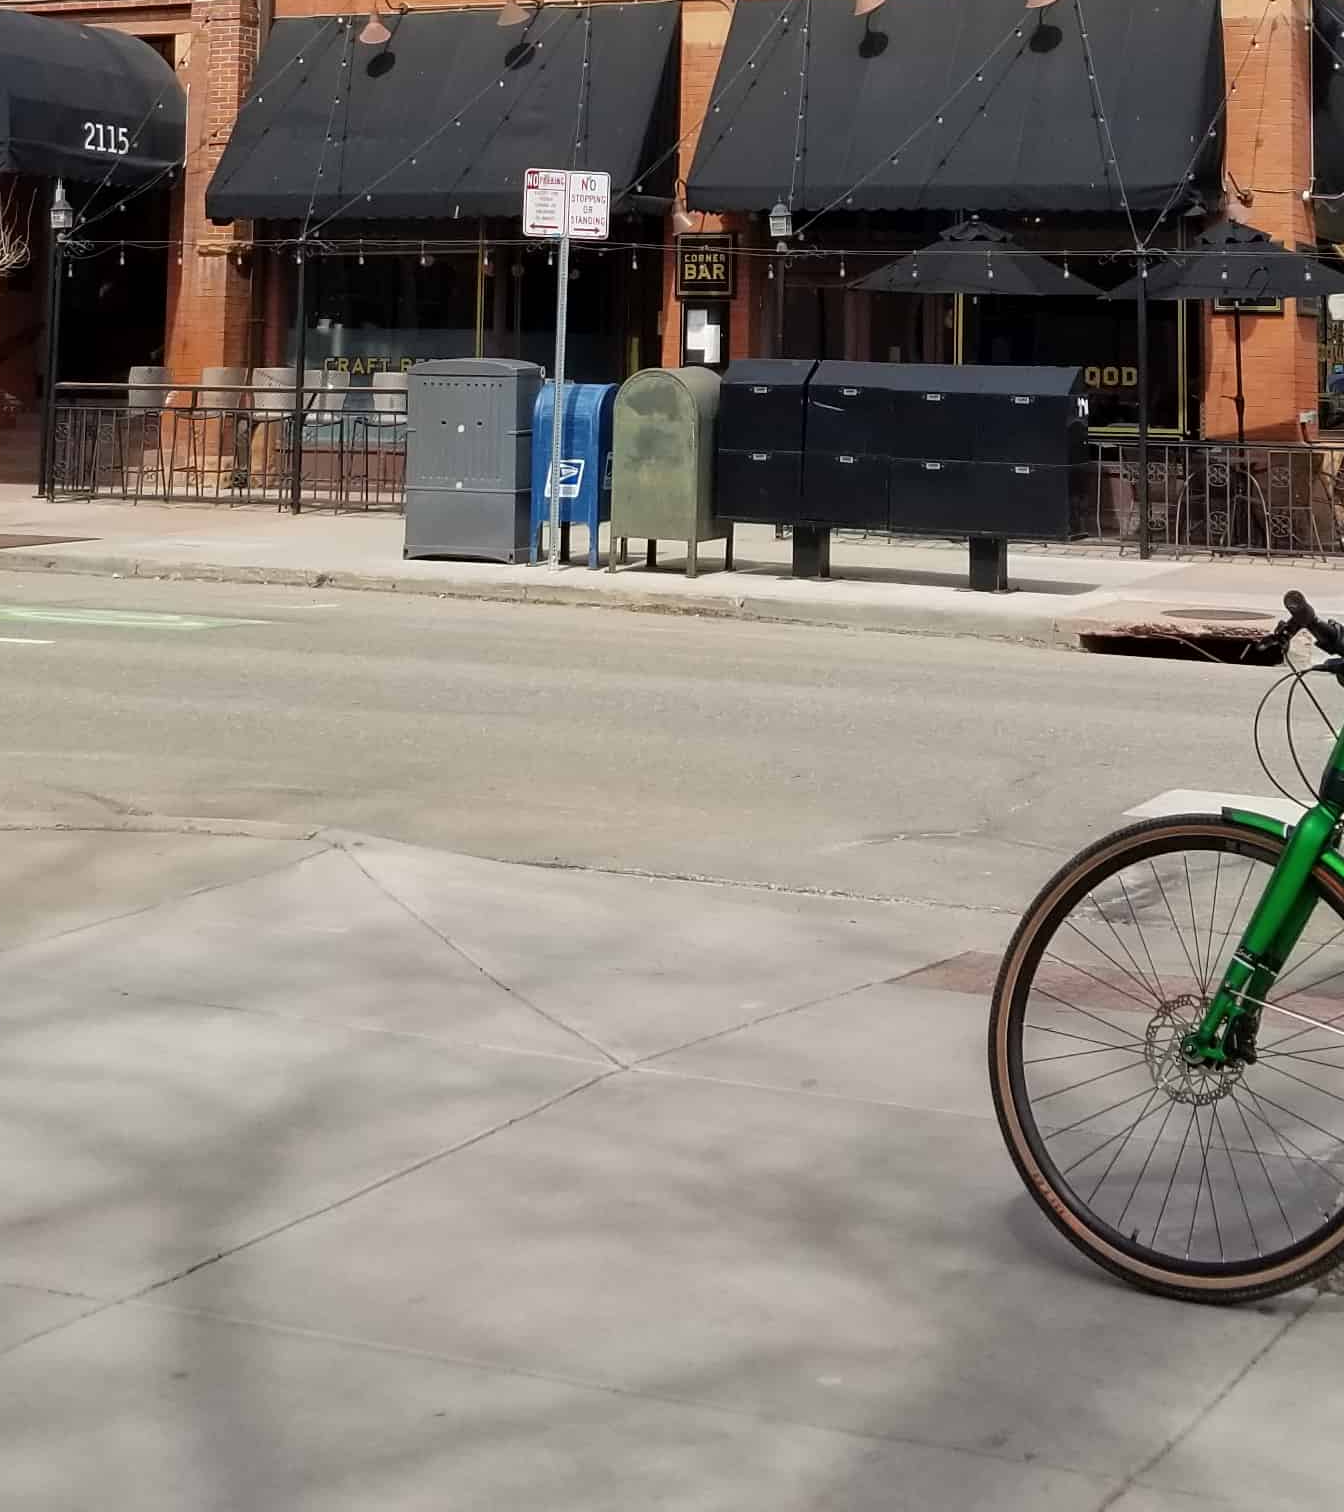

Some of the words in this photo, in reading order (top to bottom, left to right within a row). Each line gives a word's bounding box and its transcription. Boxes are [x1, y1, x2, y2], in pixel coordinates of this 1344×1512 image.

[83, 122, 130, 155] 2115
[528, 174, 539, 186] NO
[581, 177, 597, 191] NO
[571, 194, 607, 204] STOPPING
[570, 215, 606, 226] STANDING
[684, 253, 726, 262] CORNER
[684, 264, 726, 280] BAR
[324, 357, 391, 375] CRAFT
[1084, 366, 1138, 388] OOD
